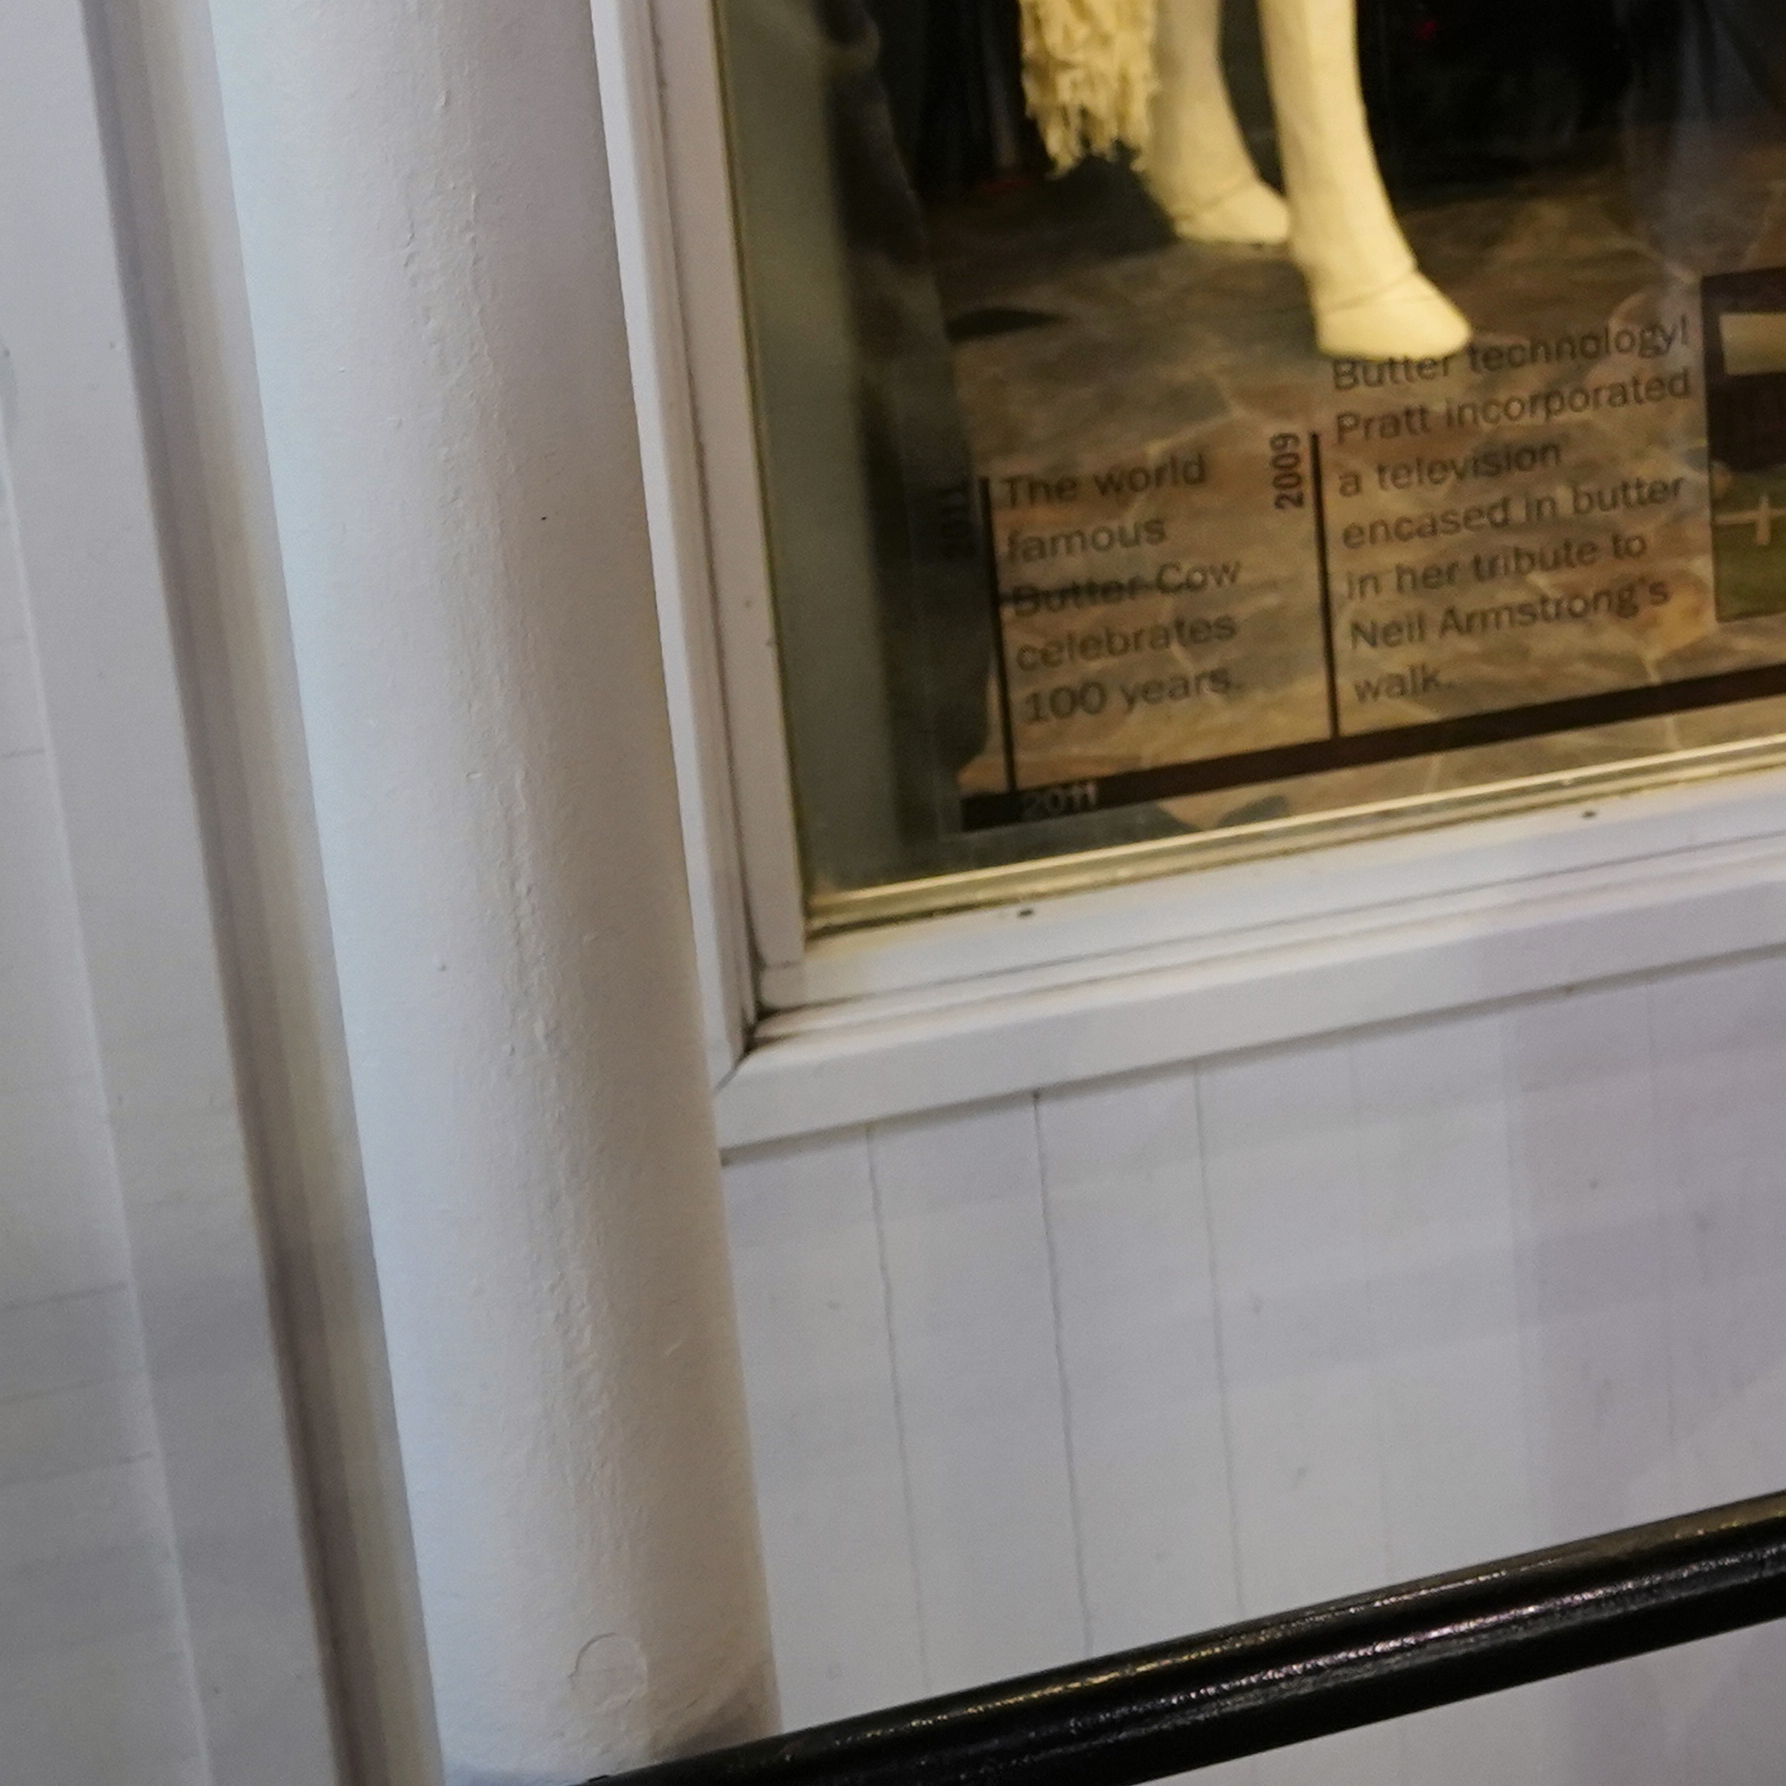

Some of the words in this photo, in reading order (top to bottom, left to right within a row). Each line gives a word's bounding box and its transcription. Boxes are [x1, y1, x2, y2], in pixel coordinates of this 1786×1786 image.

[1333, 354, 1453, 392] Butter
[1468, 315, 1690, 376] technology!
[1335, 405, 1430, 445] Pratt
[1446, 368, 1691, 431] incorporated
[1002, 473, 1078, 509] The
[1094, 453, 1208, 495] world
[1268, 431, 1305, 511] 2009
[1339, 467, 1362, 498] a
[1377, 442, 1563, 491] television
[1006, 516, 1169, 565] famous
[1342, 499, 1511, 550] encased
[1524, 493, 1556, 522] in
[1572, 474, 1685, 514] butter
[1011, 576, 1144, 617] Butter
[1155, 558, 1242, 595] Cow
[1346, 570, 1380, 601] in
[1396, 555, 1458, 593] her
[1473, 537, 1597, 583] tribute
[1612, 530, 1647, 560] to
[1016, 612, 1239, 673] celebrates
[1349, 612, 1426, 651] Neil
[1438, 577, 1670, 641] Armstrong's
[1023, 681, 1107, 725] 100
[1120, 667, 1244, 712] years.
[1353, 661, 1454, 704] walk.
